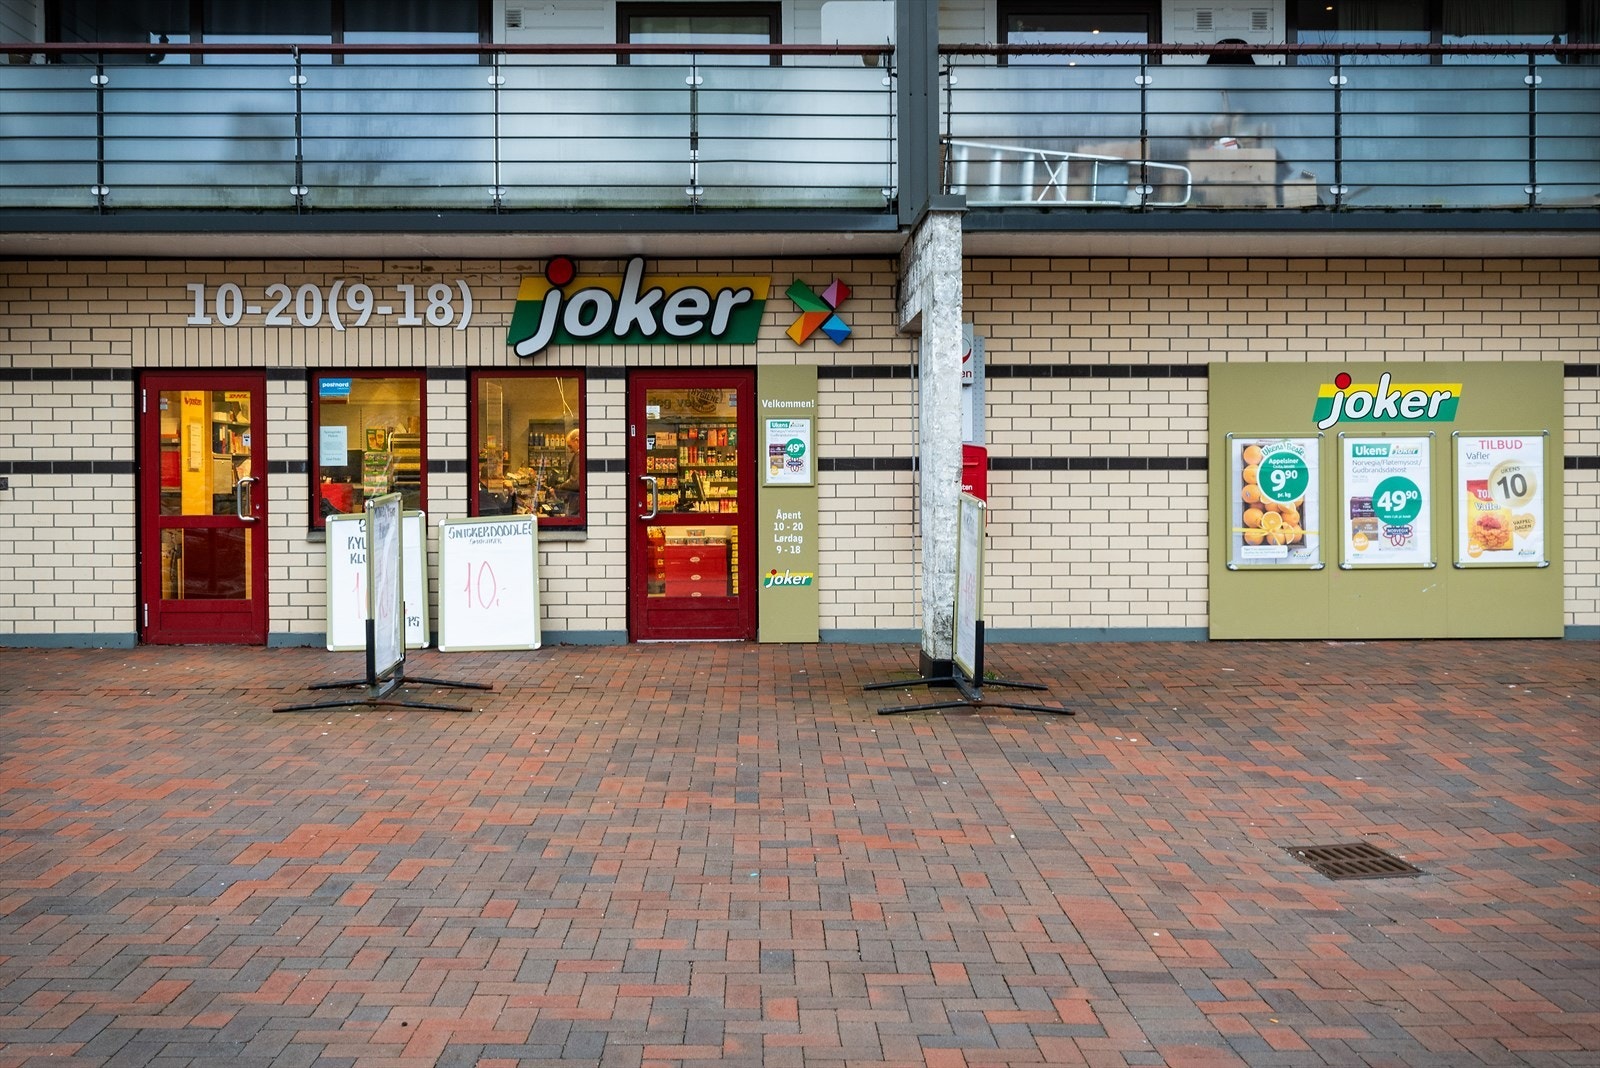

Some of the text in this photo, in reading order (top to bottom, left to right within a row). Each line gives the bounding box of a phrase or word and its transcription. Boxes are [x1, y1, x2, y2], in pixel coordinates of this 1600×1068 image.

[186, 279, 473, 331] 10-20(9-18)
[514, 254, 754, 358] joker
[762, 399, 815, 408] Velkommen!
[1317, 372, 1452, 431] joker
[1478, 439, 1523, 450] TILBUD
[1355, 445, 1387, 456] Ukens
[1466, 451, 1491, 460] Vafler
[1500, 466, 1521, 474] UKENS
[1496, 473, 1528, 499] 10
[776, 508, 802, 521] Åpent
[774, 522, 785, 531] 10
[793, 522, 803, 531] 20
[774, 533, 803, 544] Lørdag
[776, 546, 782, 554] 9
[790, 546, 801, 554] 18
[765, 568, 811, 588] joker
